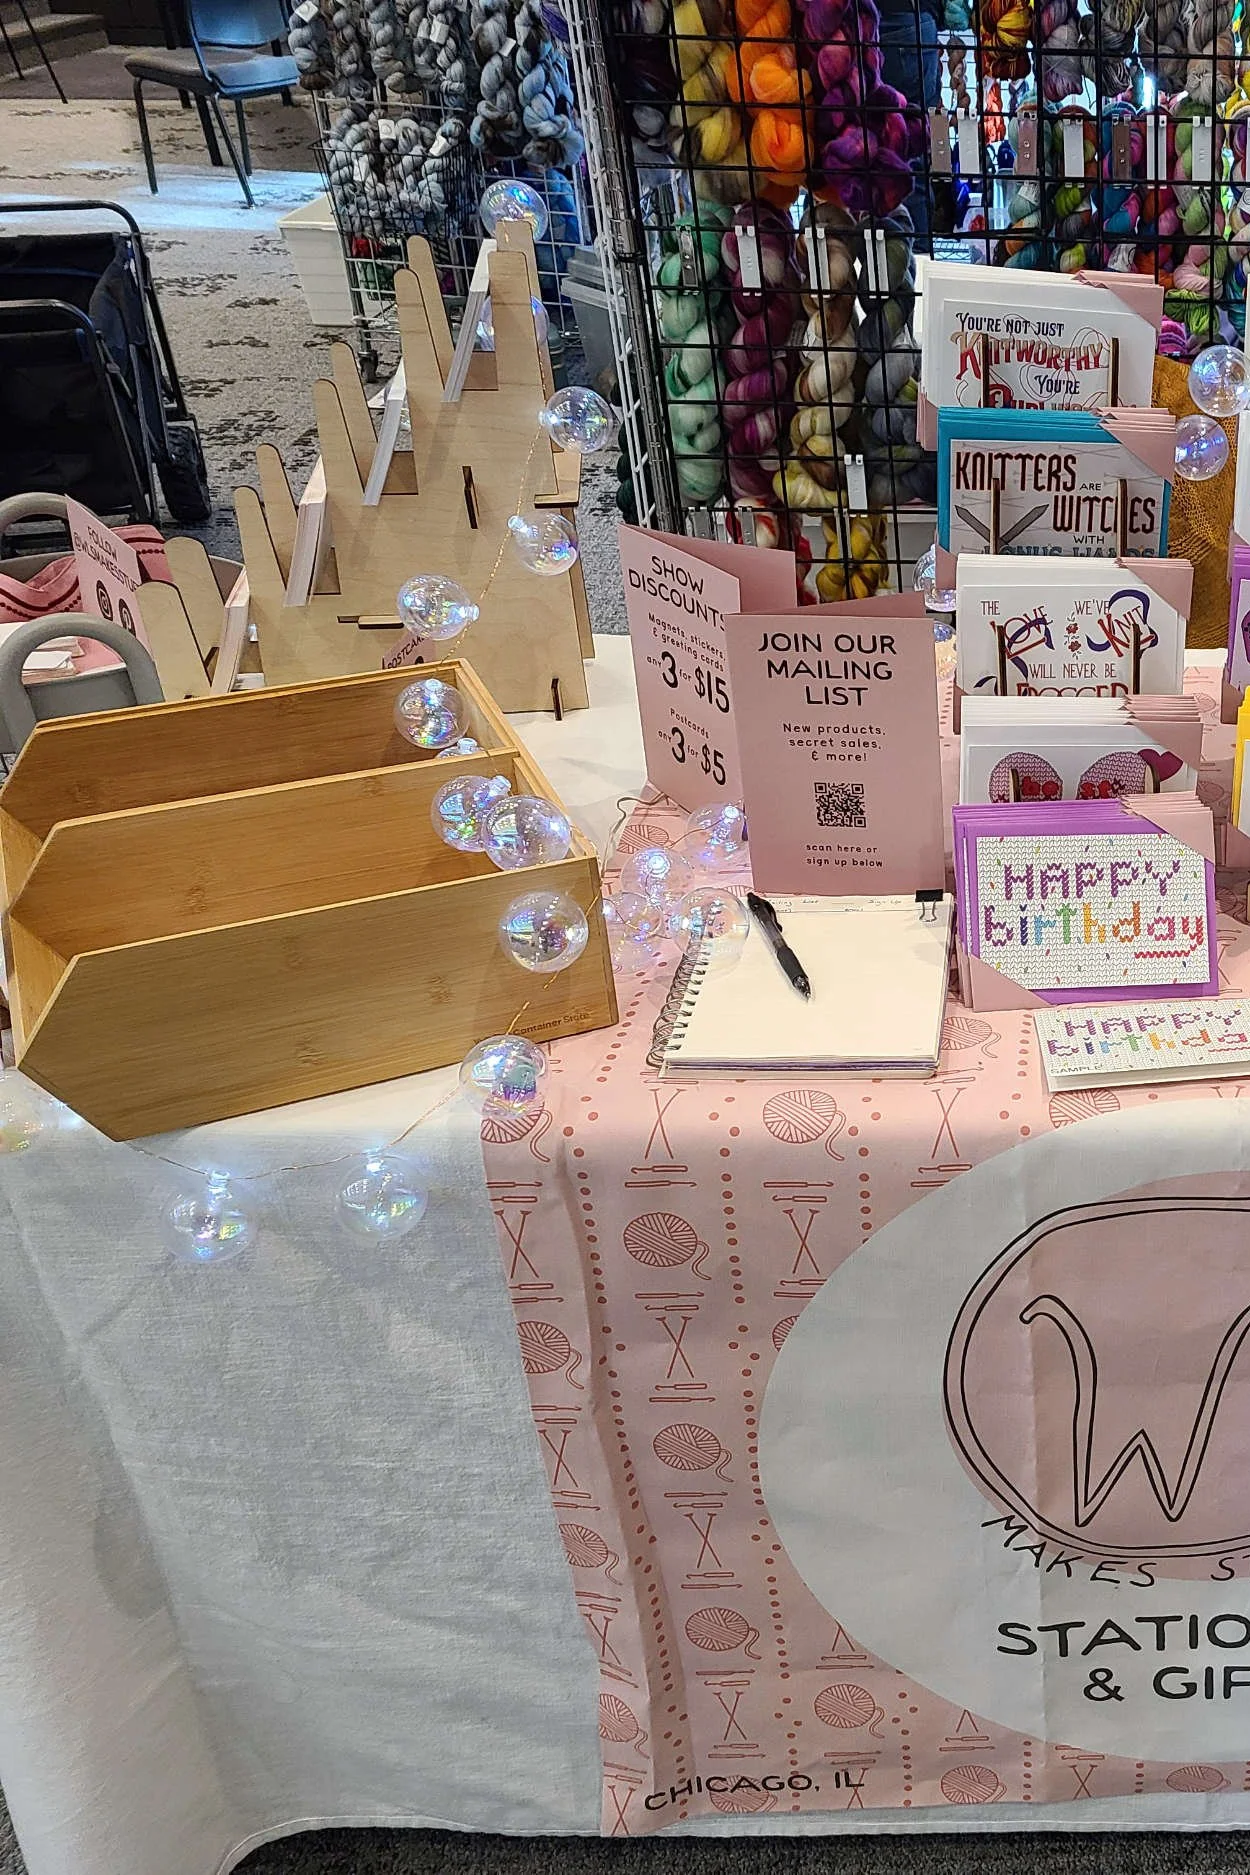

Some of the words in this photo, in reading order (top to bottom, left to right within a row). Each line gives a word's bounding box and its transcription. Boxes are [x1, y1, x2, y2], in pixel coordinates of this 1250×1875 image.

[955, 312, 1001, 334] YOU'RE
[1005, 319, 1030, 335] NOT
[1034, 321, 1064, 337] JUST
[1034, 374, 1080, 395] YOU'RE
[955, 451, 1077, 493] KNITTERS
[1079, 482, 1101, 492] ARE
[1053, 495, 1156, 534] WITCES
[88, 526, 118, 562] FOLLOW
[1074, 535, 1105, 545] WITH
[651, 554, 704, 595] SHOW
[981, 600, 1000, 616] THE
[1074, 599, 1111, 616] WE'VE
[661, 634, 697, 660] greeting
[700, 654, 724, 672] cards
[758, 632, 822, 653] JOIN
[834, 633, 897, 655] OUR
[647, 656, 661, 668] any
[661, 651, 679, 688] 3
[679, 669, 691, 681] for
[694, 665, 730, 713] $15
[767, 659, 893, 681] MAILING
[1029, 663, 1056, 678] WILL
[1063, 663, 1098, 678] NEVER
[1104, 663, 1117, 678] BE
[805, 687, 868, 707] LIST
[670, 707, 710, 740] Postcards
[782, 723, 811, 734] New
[817, 723, 887, 737] products,
[658, 729, 672, 744] any
[671, 726, 686, 764] 3
[687, 744, 699, 759] for
[700, 743, 726, 786] $5
[789, 738, 834, 748] secret
[840, 738, 881, 750] sales,
[826, 751, 867, 762] more!
[805, 845, 832, 853] scan
[836, 844, 861, 853] here
[866, 846, 878, 854] or
[806, 857, 830, 867] sign
[834, 859, 847, 868] up
[852, 858, 883, 868] below
[1004, 860, 1181, 900] HAPPY
[984, 901, 1204, 959] birthday
[512, 1019, 562, 1036] Container
[1065, 1008, 1242, 1037] HAPPY
[981, 1514, 1157, 1588] MAKES
[1083, 1668, 1125, 1702] &
[644, 1774, 821, 1811] CHICAGO,
[834, 1770, 865, 1789] IL
